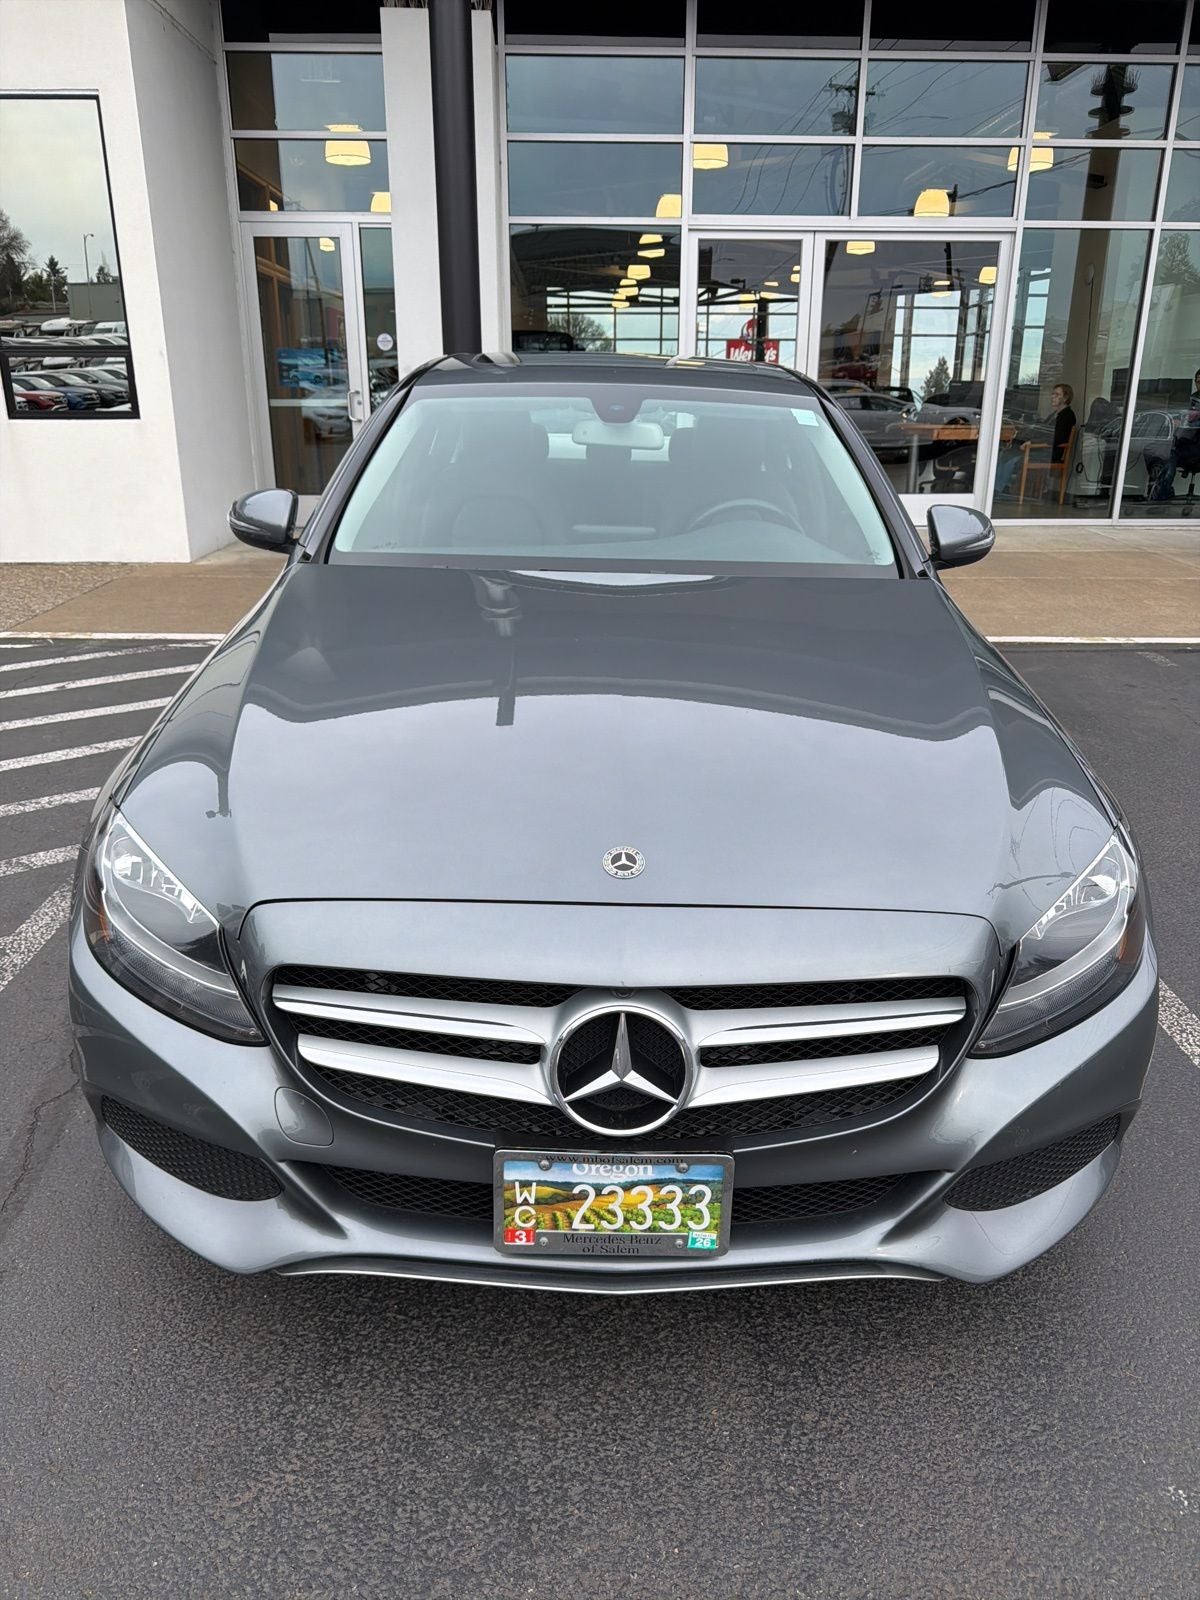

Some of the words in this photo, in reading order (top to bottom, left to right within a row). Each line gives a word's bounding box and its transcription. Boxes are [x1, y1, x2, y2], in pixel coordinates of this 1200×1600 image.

[572, 1163, 654, 1179] Oregon
[572, 1184, 712, 1231] 23333
[514, 1230, 527, 1244] 3
[695, 1238, 711, 1247] 26
[582, 1245, 598, 1255] of
[601, 1245, 640, 1255] Salem
